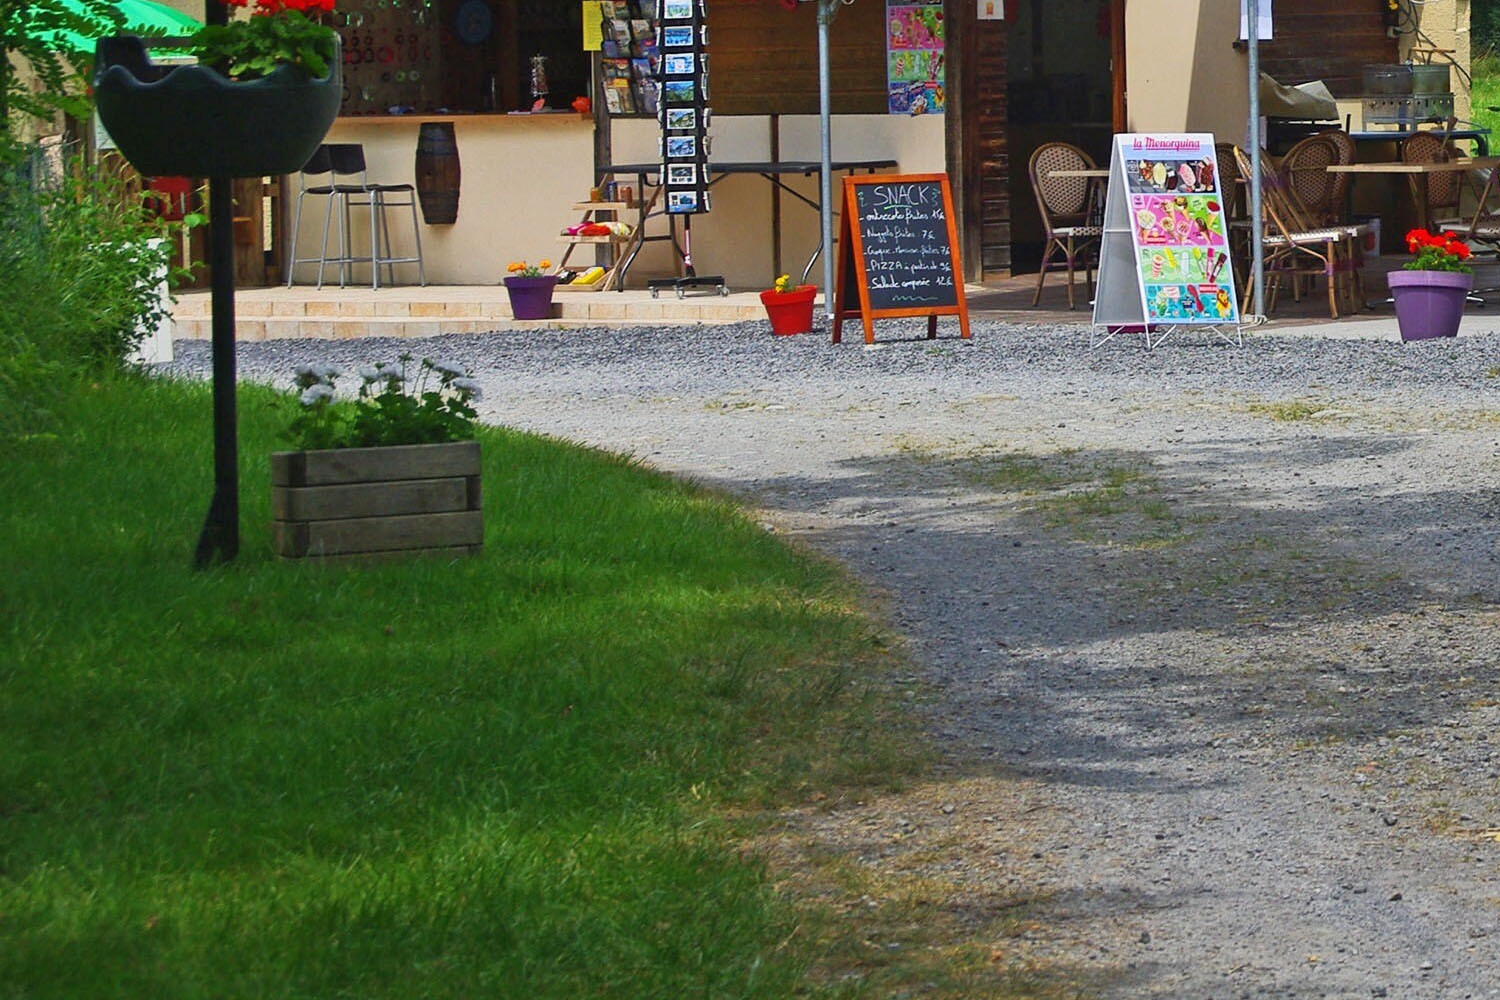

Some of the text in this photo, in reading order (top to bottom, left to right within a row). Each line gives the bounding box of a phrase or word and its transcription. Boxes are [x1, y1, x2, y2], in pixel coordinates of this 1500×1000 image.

[1145, 136, 1201, 151] Menorquina
[873, 184, 929, 206] SNACK
[870, 259, 903, 272] PIZZA
